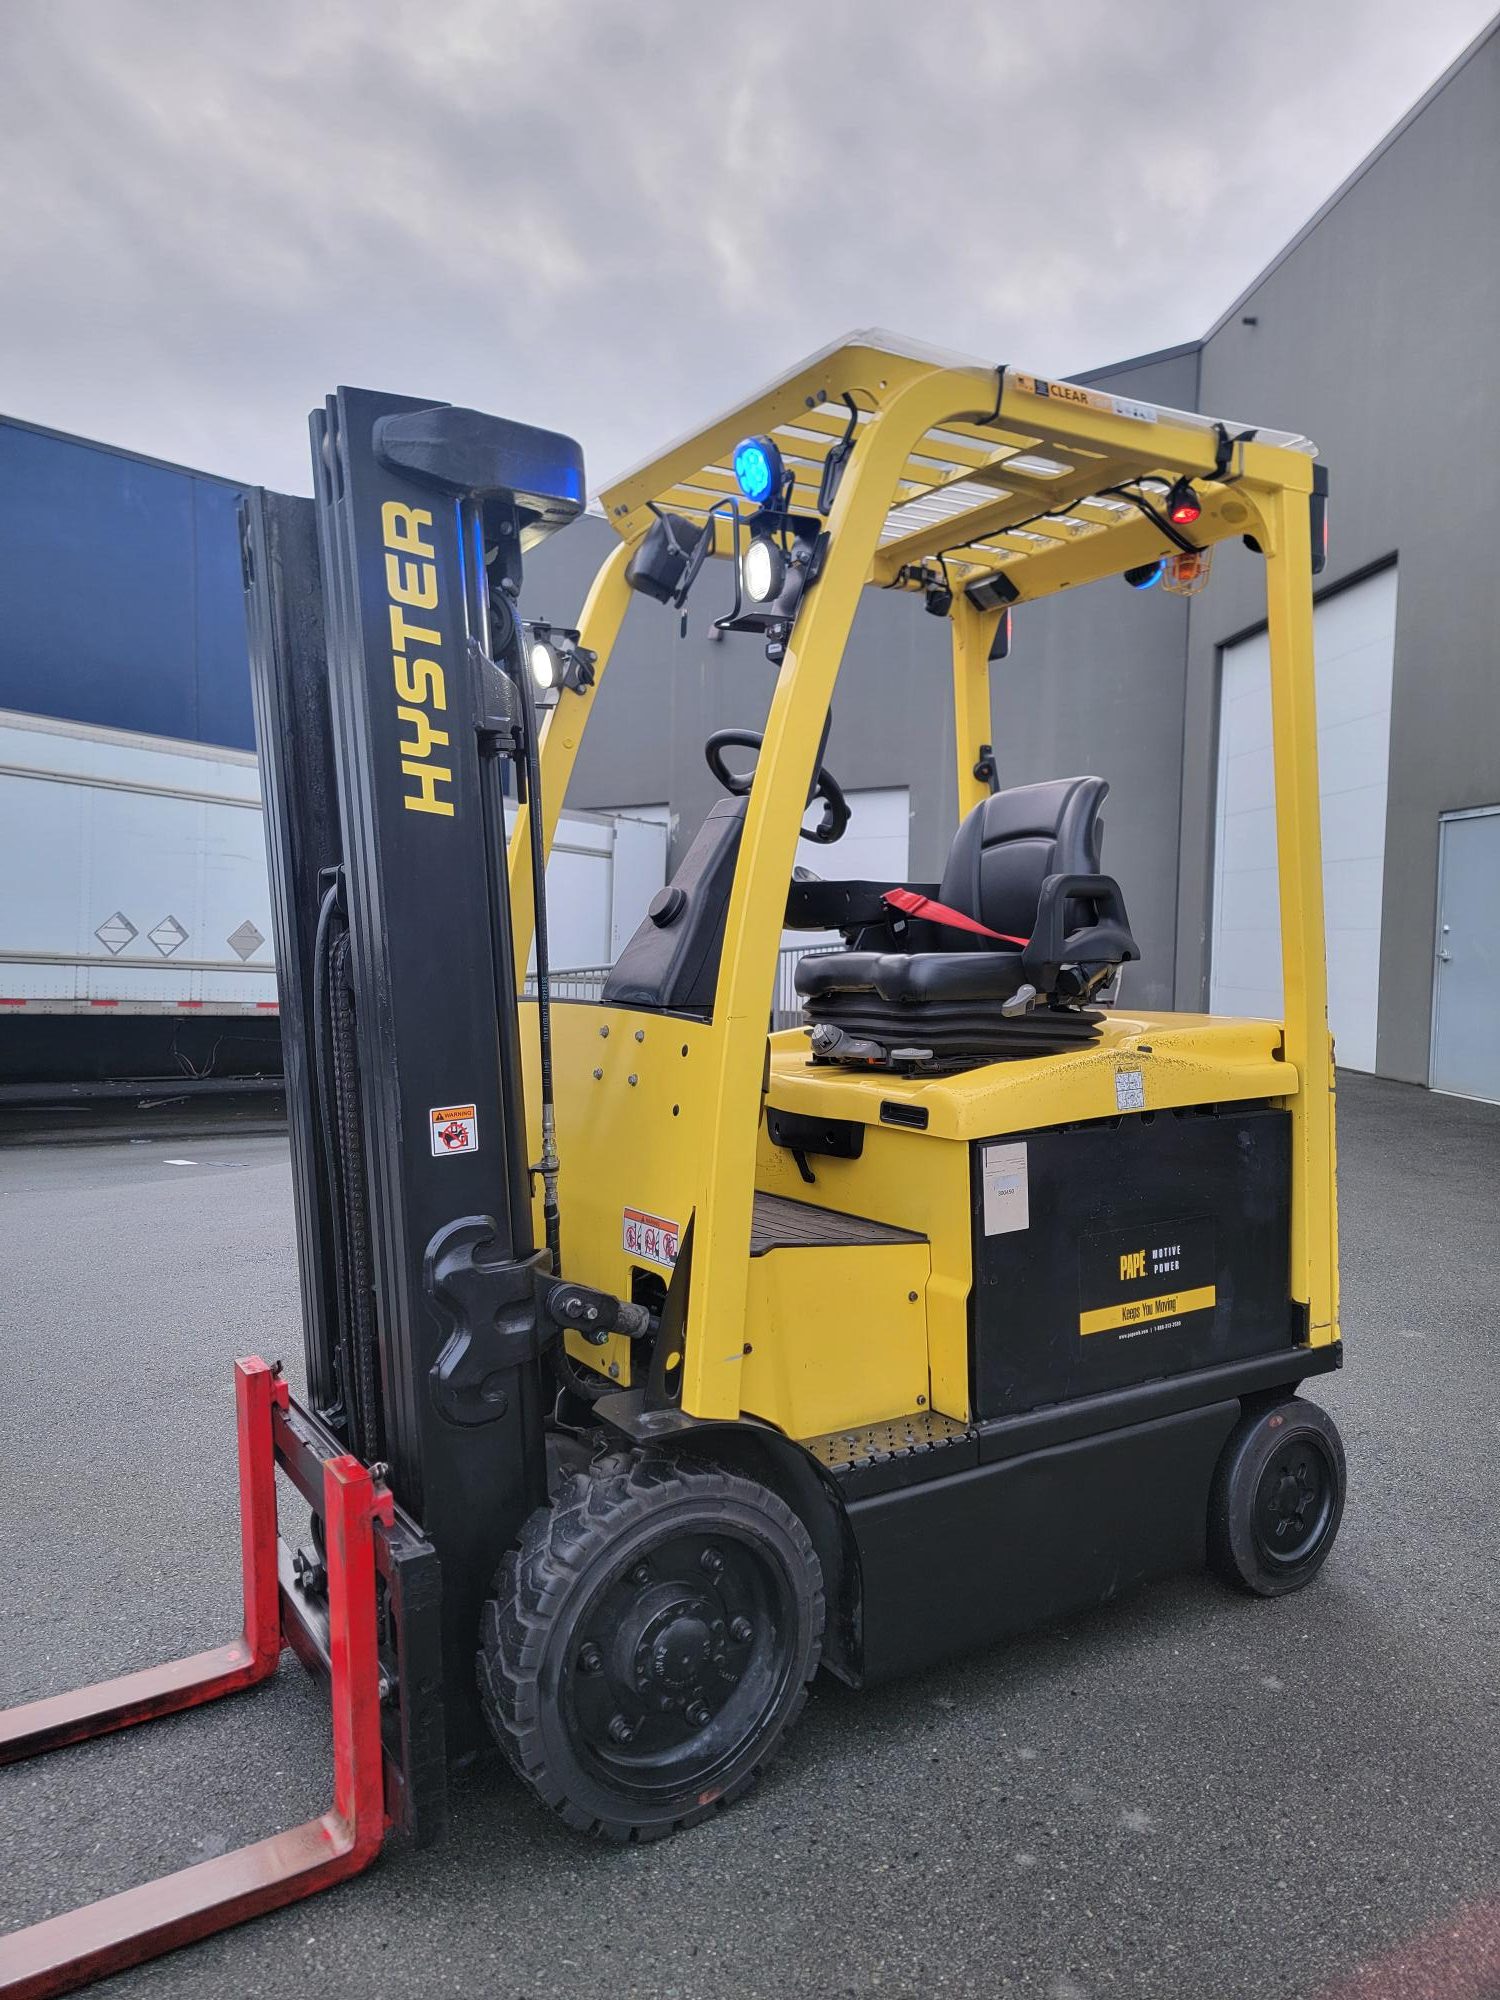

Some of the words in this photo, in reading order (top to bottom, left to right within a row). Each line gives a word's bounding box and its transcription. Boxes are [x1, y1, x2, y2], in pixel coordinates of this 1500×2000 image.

[1051, 385, 1088, 404] CLEAR
[381, 501, 454, 816] HYSTER
[1153, 1246, 1180, 1259] MOTIVE
[1154, 1261, 1179, 1274] POWER
[1122, 1306, 1140, 1321] Keeps
[1142, 1302, 1153, 1317] You
[1155, 1298, 1177, 1313] Moving
